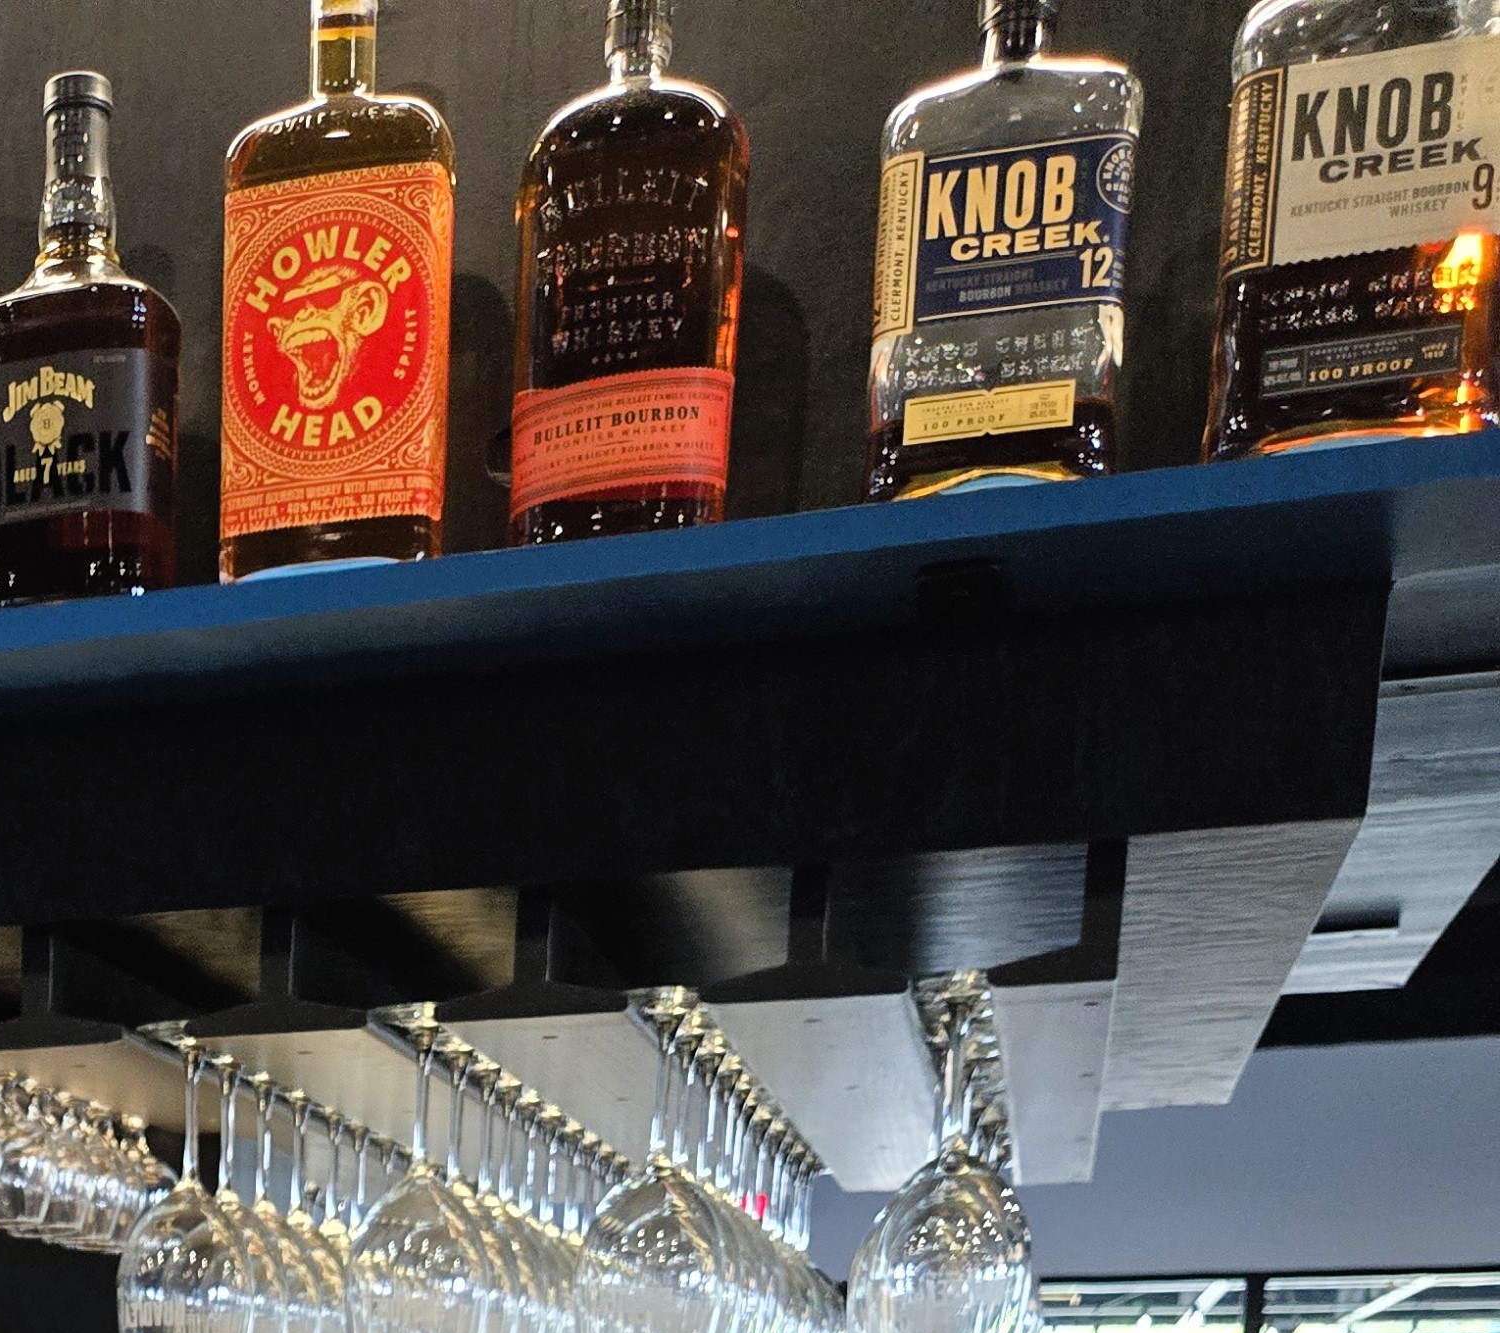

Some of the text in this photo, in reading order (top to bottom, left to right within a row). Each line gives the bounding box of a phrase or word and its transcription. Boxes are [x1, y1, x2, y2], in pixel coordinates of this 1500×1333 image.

[1256, 82, 1274, 164] KENTUCKY
[1291, 71, 1455, 162] KNOB
[1319, 137, 1483, 184] CREEK
[897, 171, 910, 241] KENTUCKY
[925, 155, 1077, 240] KNOB
[1412, 180, 1470, 199] BOURBON
[1471, 163, 1495, 211] 9
[950, 220, 1103, 261] CREEK
[245, 225, 412, 313] HOWLER
[1079, 247, 1114, 288] 12
[242, 331, 267, 405] MONKEY
[393, 308, 418, 381] SPIRIT
[1350, 358, 1414, 377] PROOF
[3, 366, 95, 423] JIM BEAM
[270, 396, 383, 447] HEAD
[533, 406, 700, 446] BULLEIT BOURBON
[957, 414, 1005, 427] PROOF
[41, 458, 54, 485] 7
